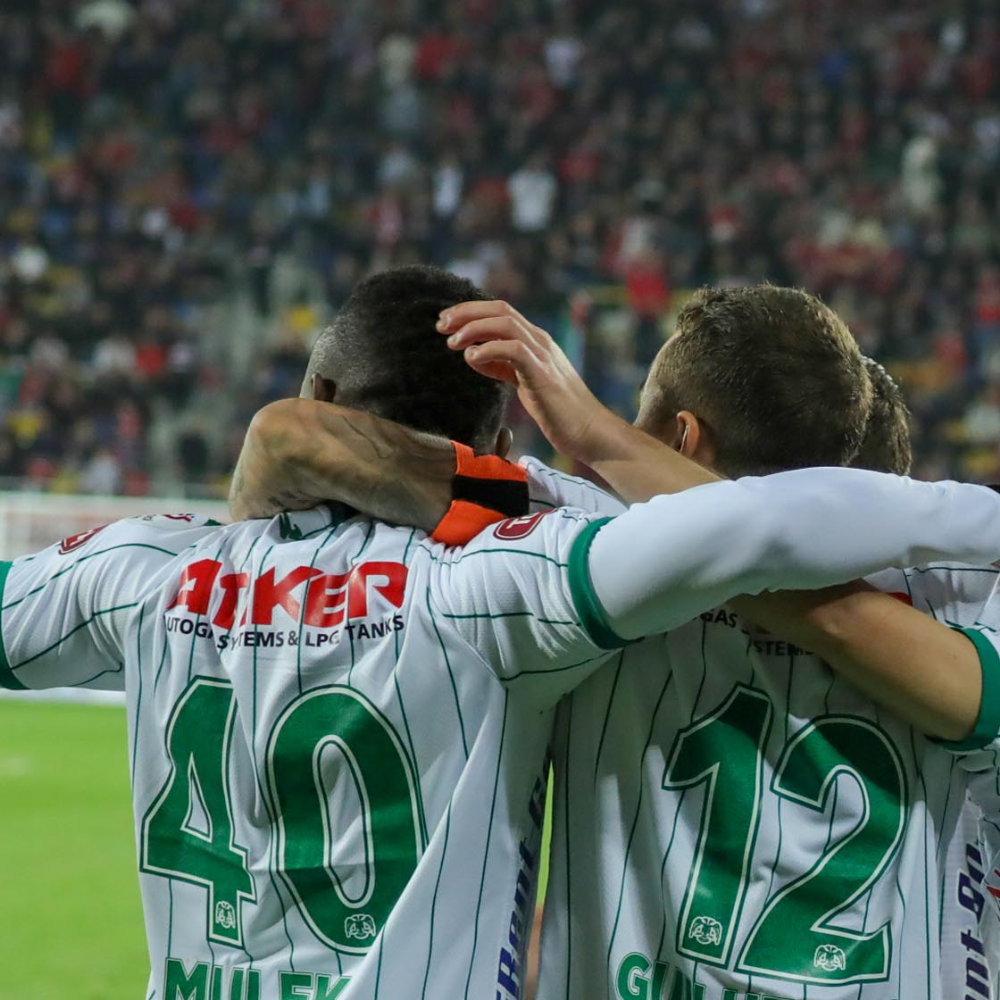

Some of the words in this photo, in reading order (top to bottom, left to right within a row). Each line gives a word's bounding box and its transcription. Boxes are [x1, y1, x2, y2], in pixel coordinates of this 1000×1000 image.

[287, 630, 299, 646] &
[345, 614, 405, 641] TANKS
[140, 674, 429, 956] 40
[661, 681, 909, 987] 12
